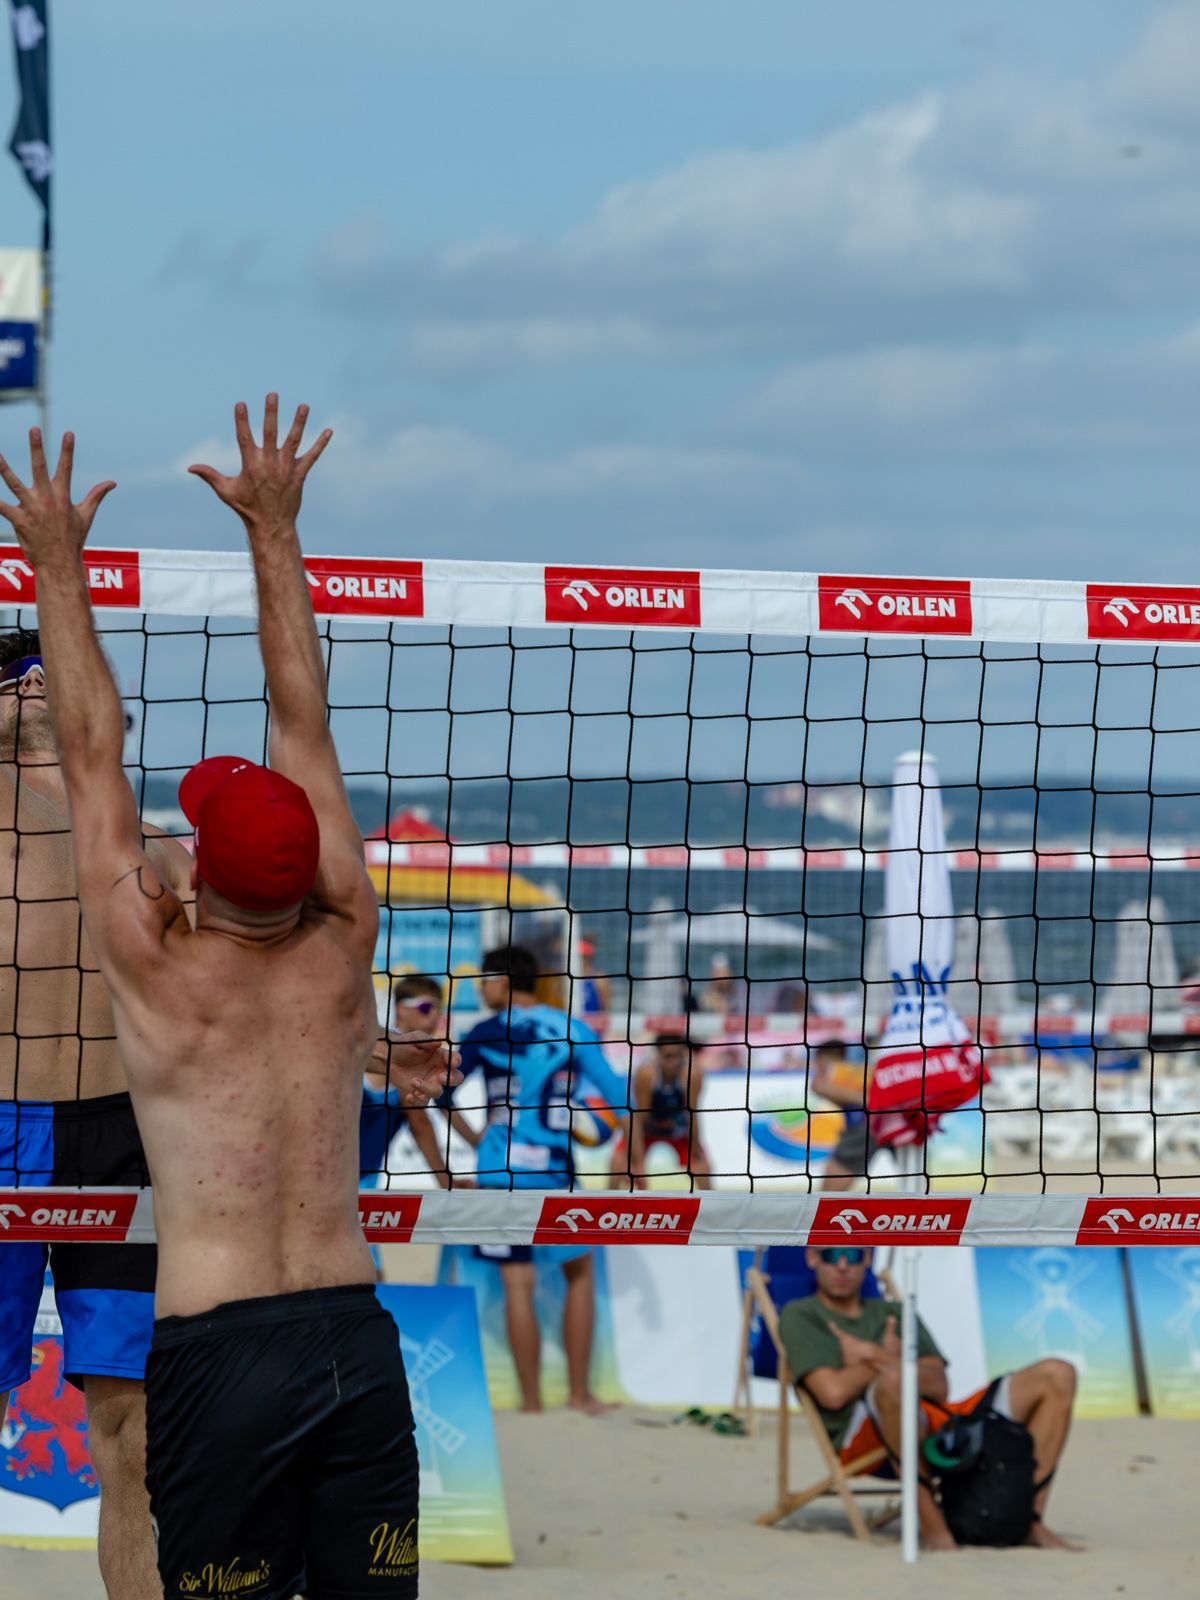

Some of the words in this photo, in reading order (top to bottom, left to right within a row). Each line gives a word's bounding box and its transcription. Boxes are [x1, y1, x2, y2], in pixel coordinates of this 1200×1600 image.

[326, 576, 407, 599] ORLEN
[605, 586, 685, 609] ORLEN
[877, 595, 956, 618] ORLEN
[30, 1209, 116, 1227] ORLEN
[358, 1211, 401, 1228] LEN
[598, 1212, 680, 1230] ORLEN
[871, 1214, 951, 1231] ORLEN
[1139, 1213, 1200, 1230] ORLE
[179, 1570, 202, 1592] Sir
[202, 1556, 271, 1593] William's
